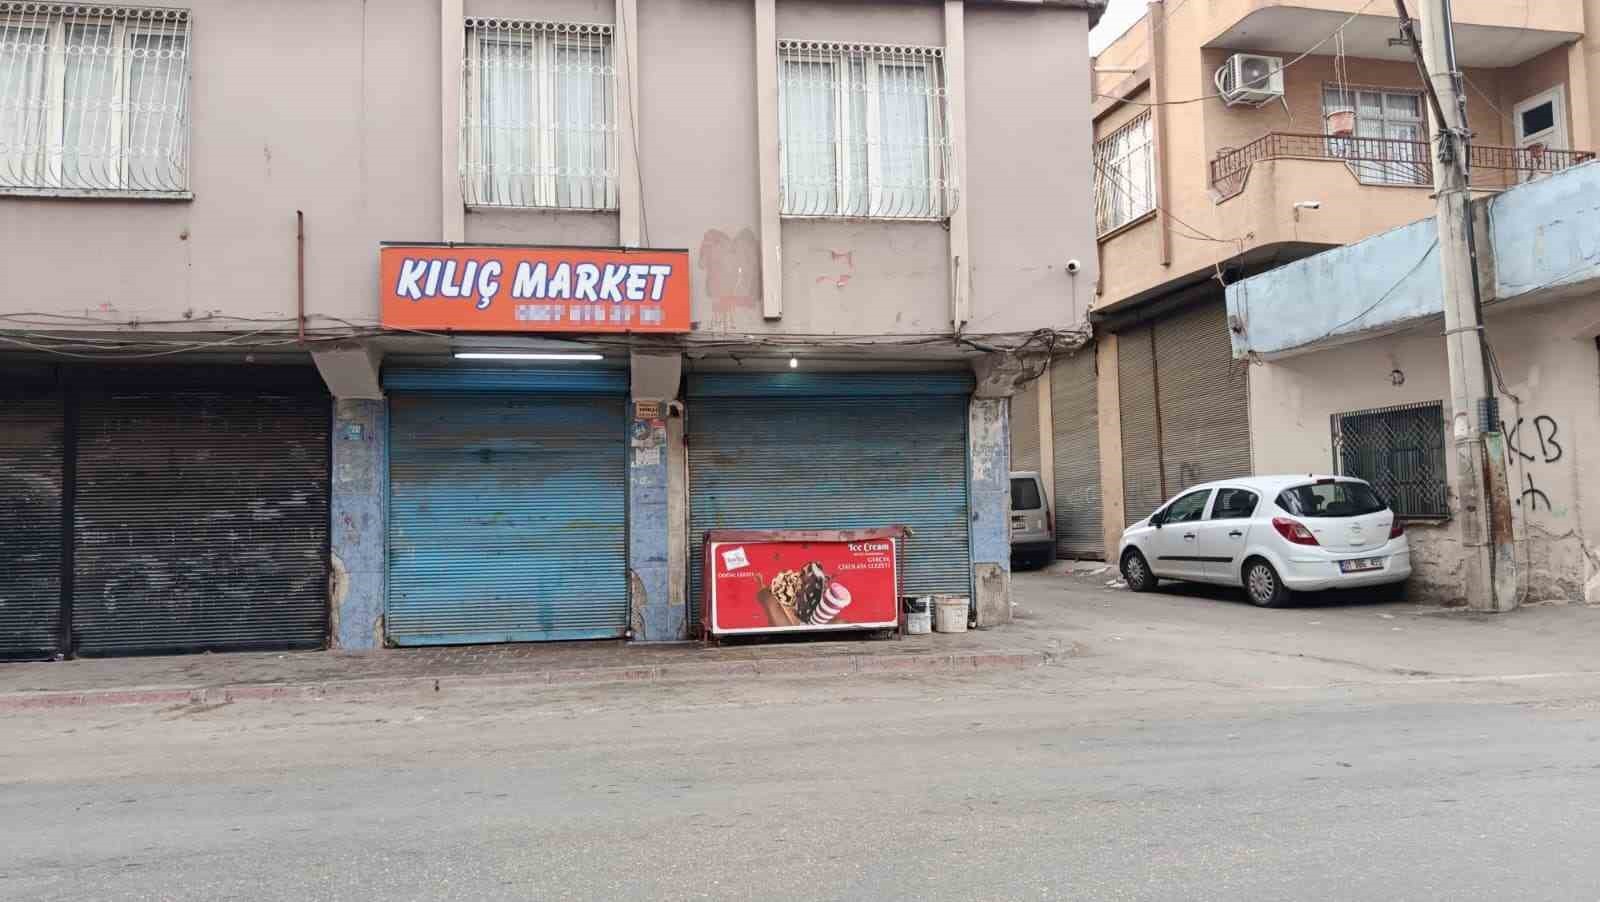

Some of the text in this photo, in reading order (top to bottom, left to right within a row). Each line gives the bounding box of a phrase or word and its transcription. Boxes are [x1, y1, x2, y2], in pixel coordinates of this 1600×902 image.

[396, 258, 672, 309] KILIÇ MARKET
[863, 542, 889, 553] Cream
